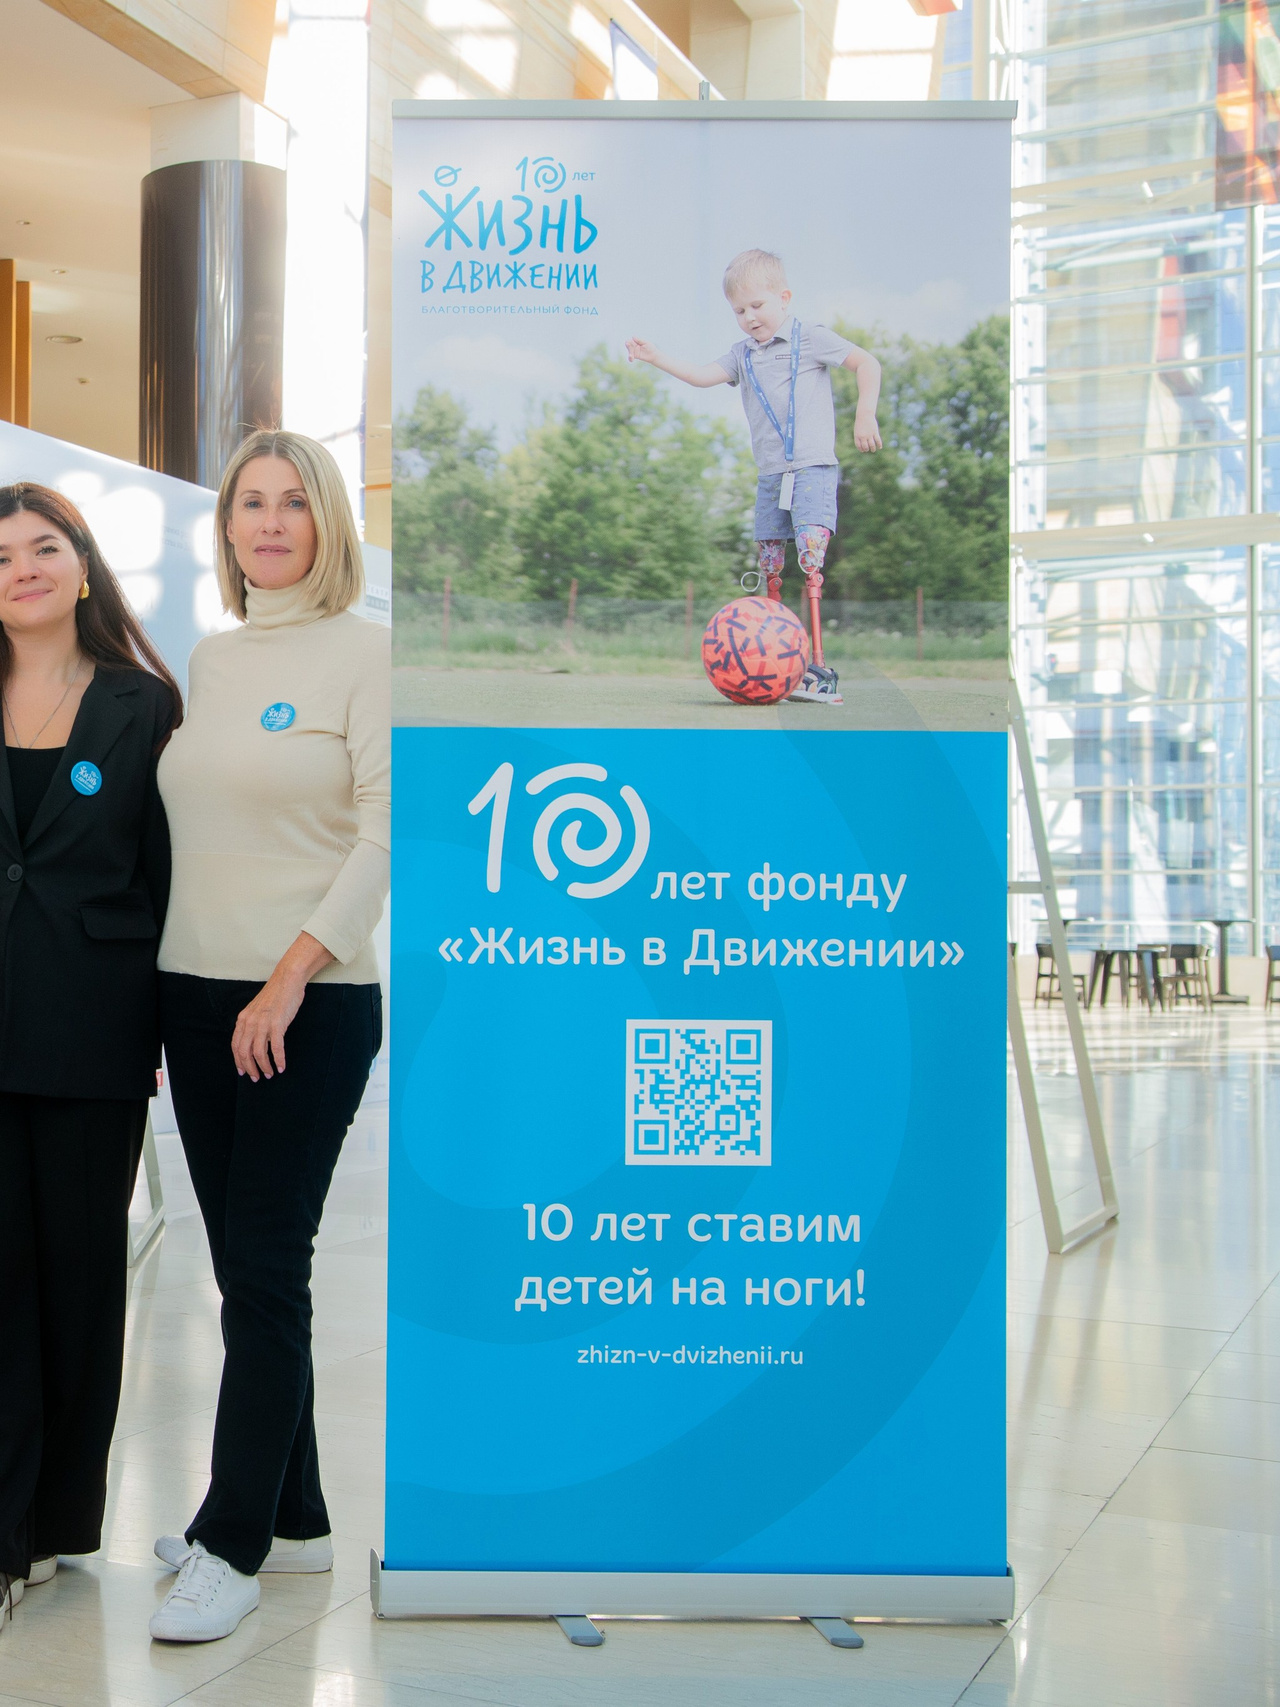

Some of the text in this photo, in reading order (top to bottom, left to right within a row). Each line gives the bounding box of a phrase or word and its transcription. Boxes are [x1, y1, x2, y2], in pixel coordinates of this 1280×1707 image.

[572, 172, 596, 181] лет
[418, 185, 598, 256] ЖИЗНЬ
[420, 260, 598, 294] В ДВИЖЕНИИ
[421, 304, 598, 315] БЛАГОТВОРИТЕЛЬНЫЙ ФОНД
[467, 761, 907, 913] 10 лет фонду
[437, 926, 965, 976] «Жизнь в Движении»
[522, 1202, 861, 1243] 10 лет ставим
[514, 1267, 866, 1312] детей на ноги!
[577, 1344, 804, 1366] zhizn-v-dvizhenii.ru
